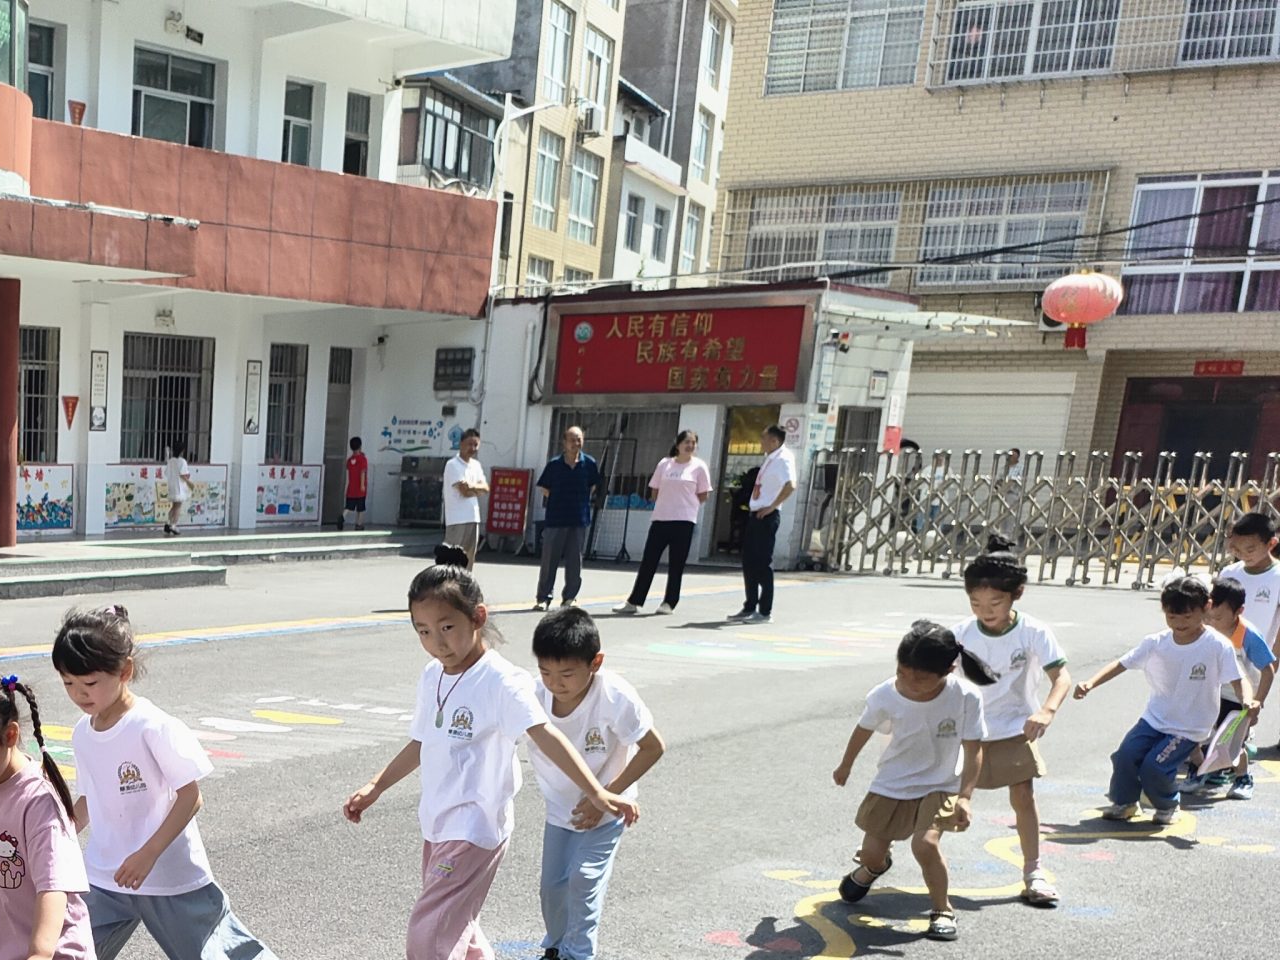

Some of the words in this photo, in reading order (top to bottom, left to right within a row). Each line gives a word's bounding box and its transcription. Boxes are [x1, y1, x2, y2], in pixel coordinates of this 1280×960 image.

[606, 312, 713, 339] 人民有信仰
[636, 337, 745, 364] 民族有希望
[667, 364, 778, 391] 国家有力量
